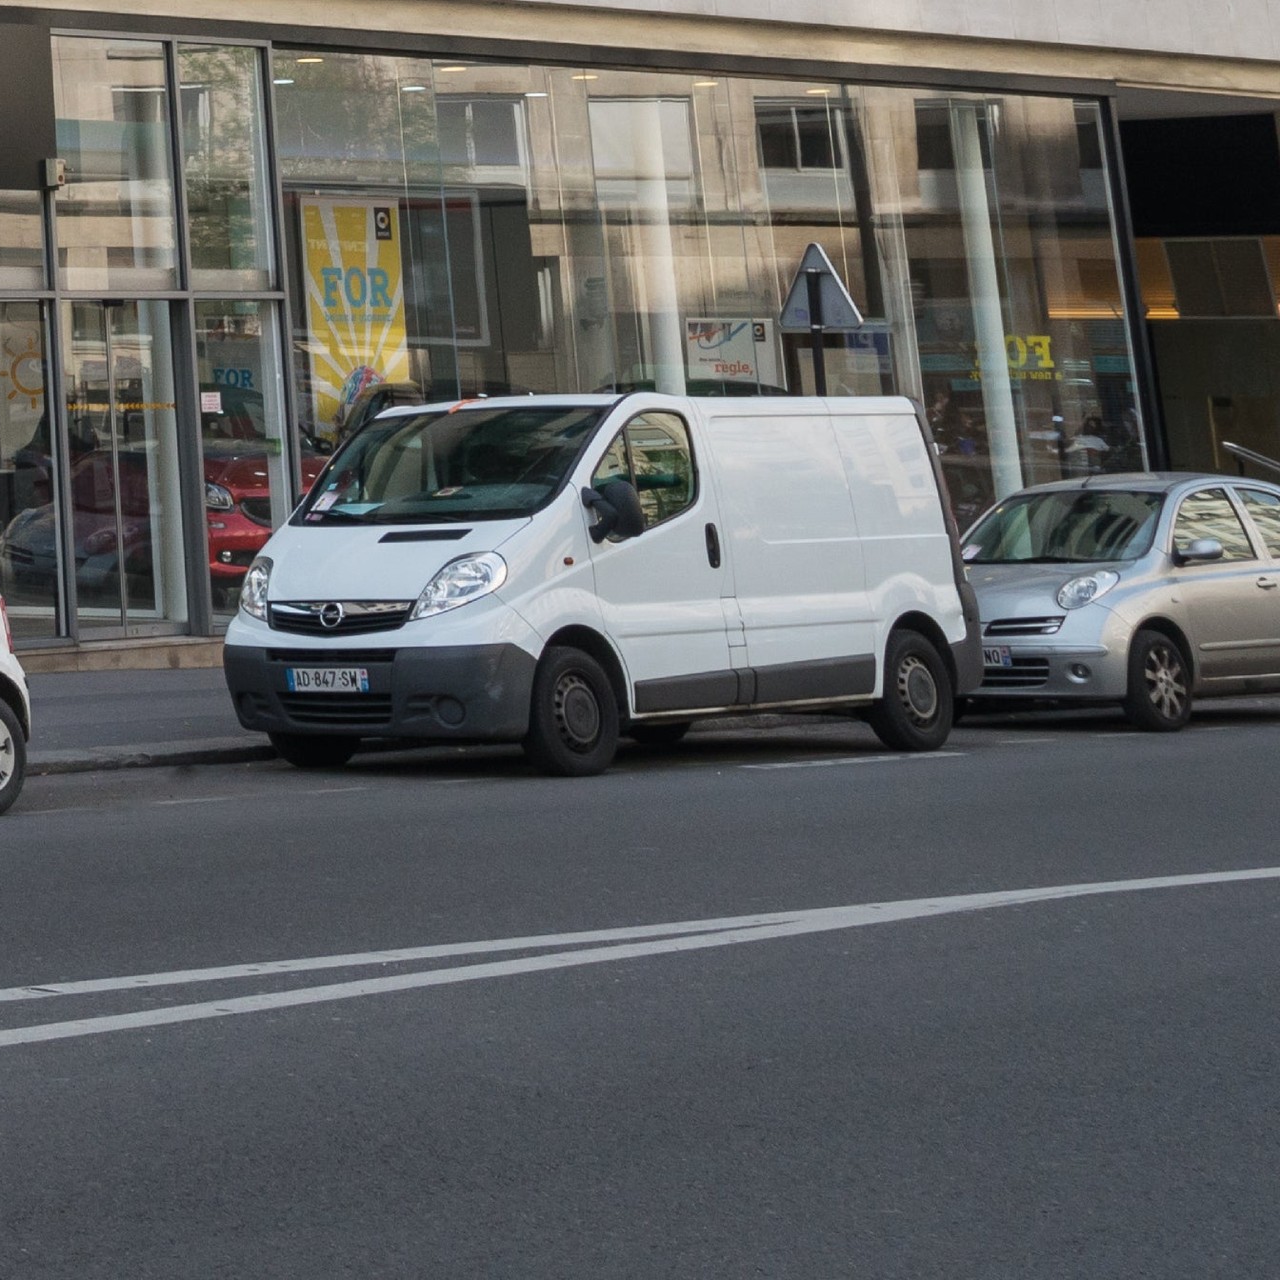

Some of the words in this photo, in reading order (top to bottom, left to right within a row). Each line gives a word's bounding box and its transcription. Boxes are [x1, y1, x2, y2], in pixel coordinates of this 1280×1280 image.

[320, 265, 393, 308] FOR
[213, 367, 255, 388] FOR
[714, 359, 754, 376] règle,
